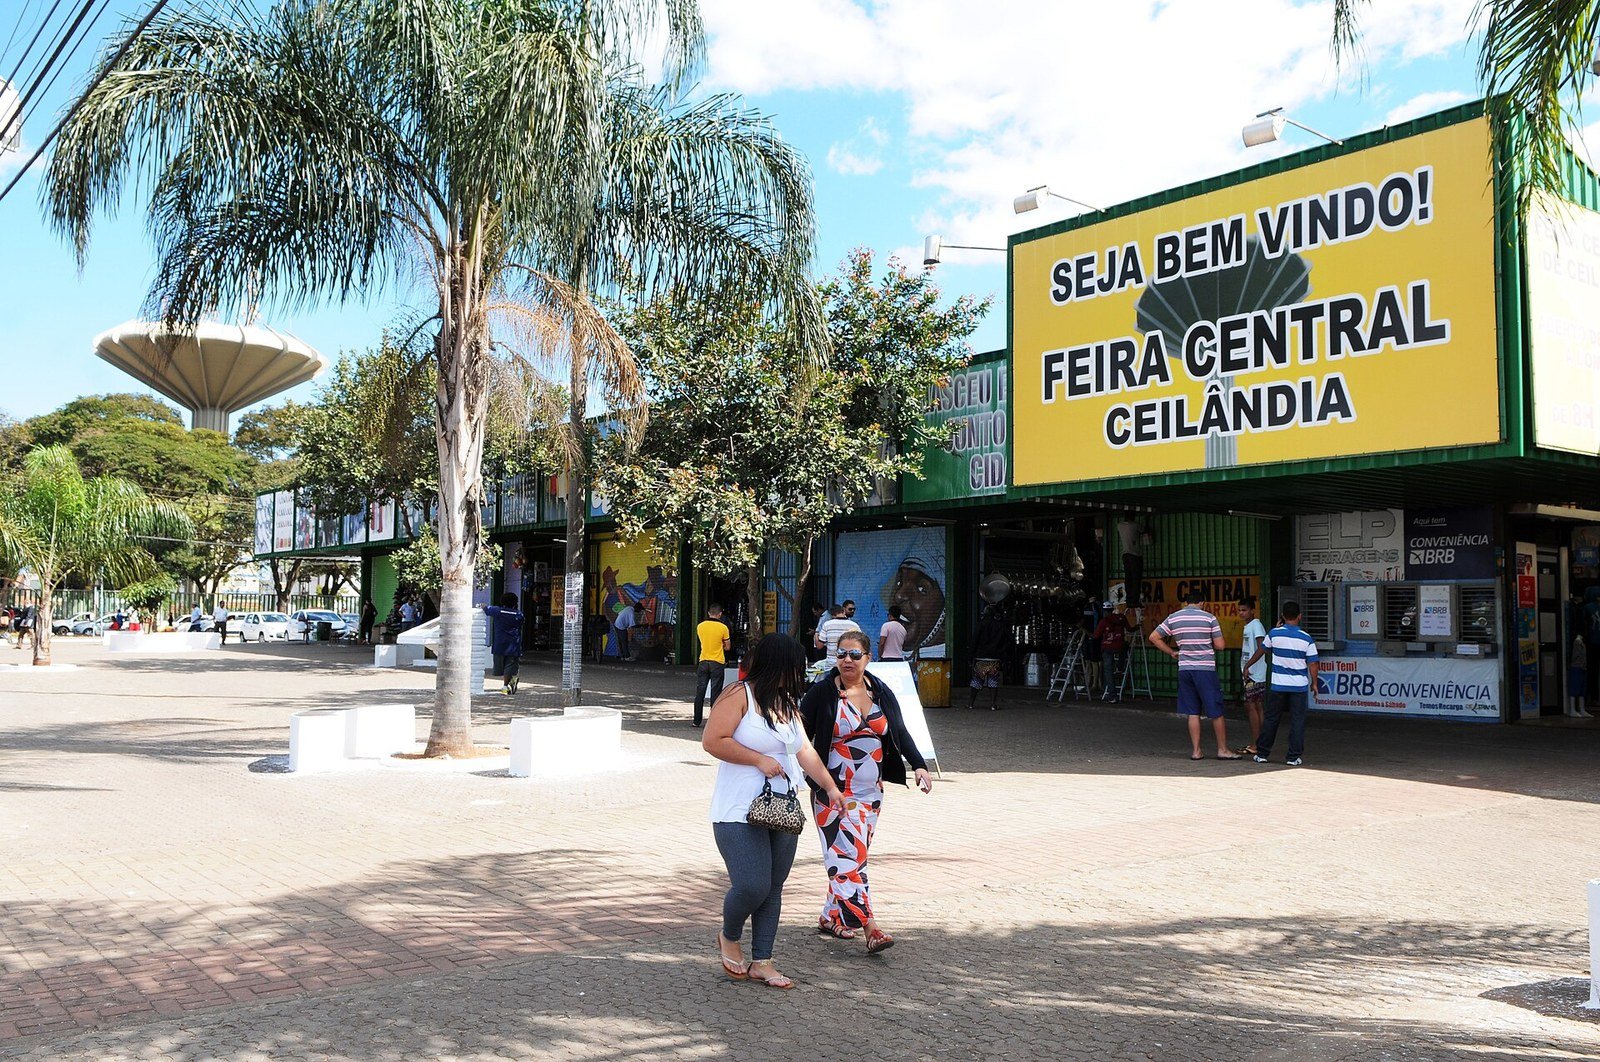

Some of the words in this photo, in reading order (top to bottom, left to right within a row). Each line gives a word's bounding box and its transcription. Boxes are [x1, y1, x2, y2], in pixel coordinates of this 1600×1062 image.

[1051, 243, 1144, 304] SEJA
[1156, 217, 1244, 279] BEM
[1257, 168, 1433, 255] VINDO!
[1042, 334, 1171, 402] FEIRA
[1184, 282, 1449, 378] CENTRAL
[1105, 375, 1353, 447] CEILÂNDIA
[1299, 508, 1396, 550] ELP
[1413, 517, 1430, 526] Aqui
[1431, 516, 1446, 525] tem
[1410, 533, 1490, 548] CONVENIÊNCIA
[1299, 549, 1399, 565] FERRAGENS
[1426, 548, 1455, 565] BRB
[1176, 578, 1256, 603] CENTRAL
[1361, 605, 1374, 613] BRB
[1432, 606, 1448, 615] BRB
[1360, 620, 1370, 628] 02
[1337, 660, 1358, 673] Tem!
[1336, 673, 1376, 696] BRB
[1379, 680, 1491, 701] CONVENIÊNCIA
